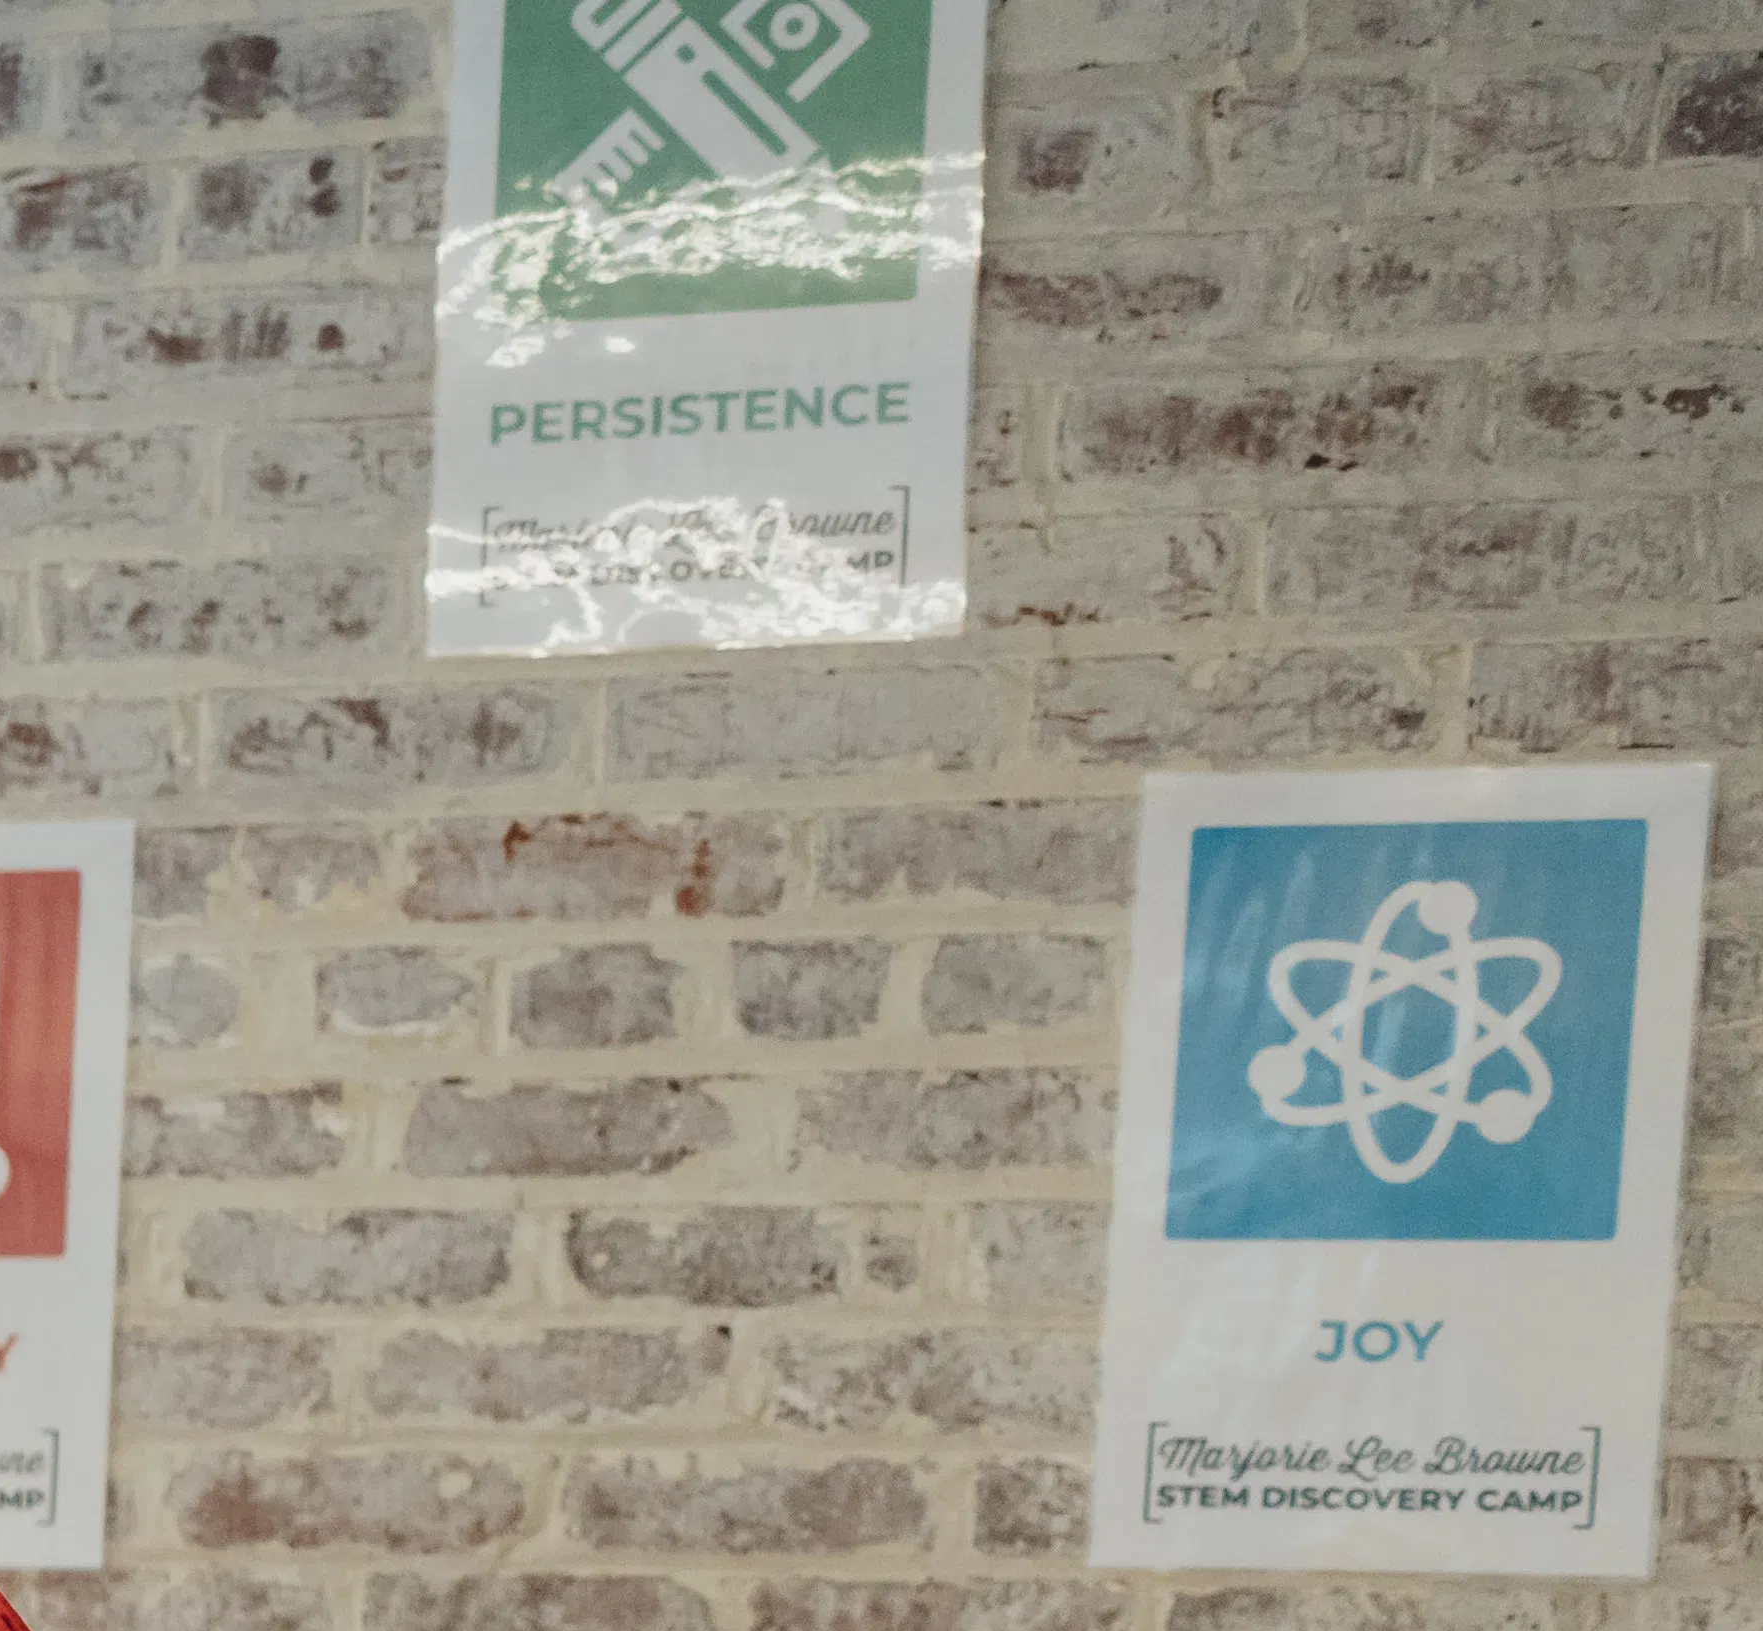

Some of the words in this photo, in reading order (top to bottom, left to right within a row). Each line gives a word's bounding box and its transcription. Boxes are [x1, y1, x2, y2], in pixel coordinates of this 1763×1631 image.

[490, 381, 912, 446] PERSISTENCE
[1314, 1320, 1444, 1362] JOY
[1158, 1437, 1331, 1481] Marjorie
[1338, 1436, 1415, 1481] Lee
[1424, 1437, 1585, 1475] Browne
[1156, 1484, 1250, 1510] STEM
[1261, 1486, 1466, 1512] DISCOVERY
[1475, 1489, 1583, 1514] CAMP
